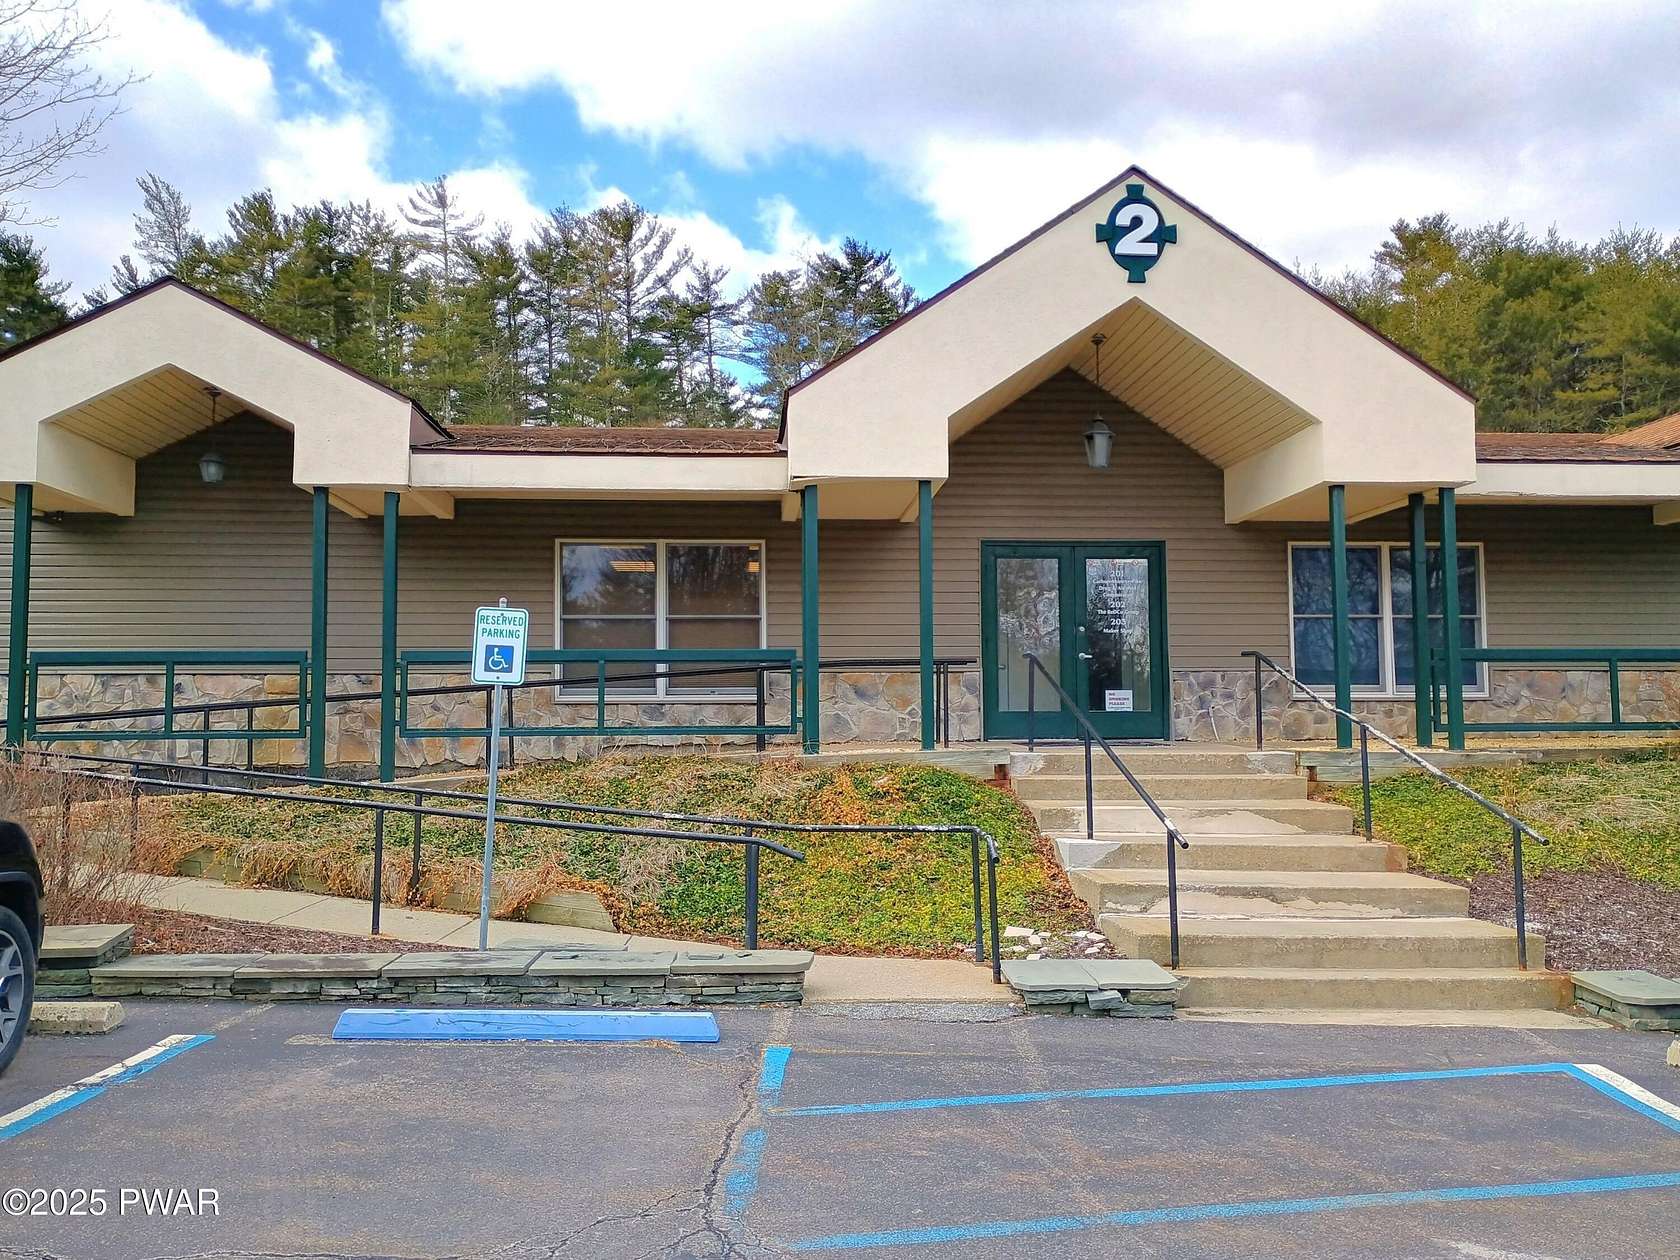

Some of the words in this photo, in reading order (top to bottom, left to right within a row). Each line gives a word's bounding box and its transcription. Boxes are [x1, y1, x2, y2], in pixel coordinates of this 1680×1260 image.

[1115, 203, 1159, 257] 2
[480, 615, 524, 627] RESERVED
[483, 628, 521, 639] PARKING
